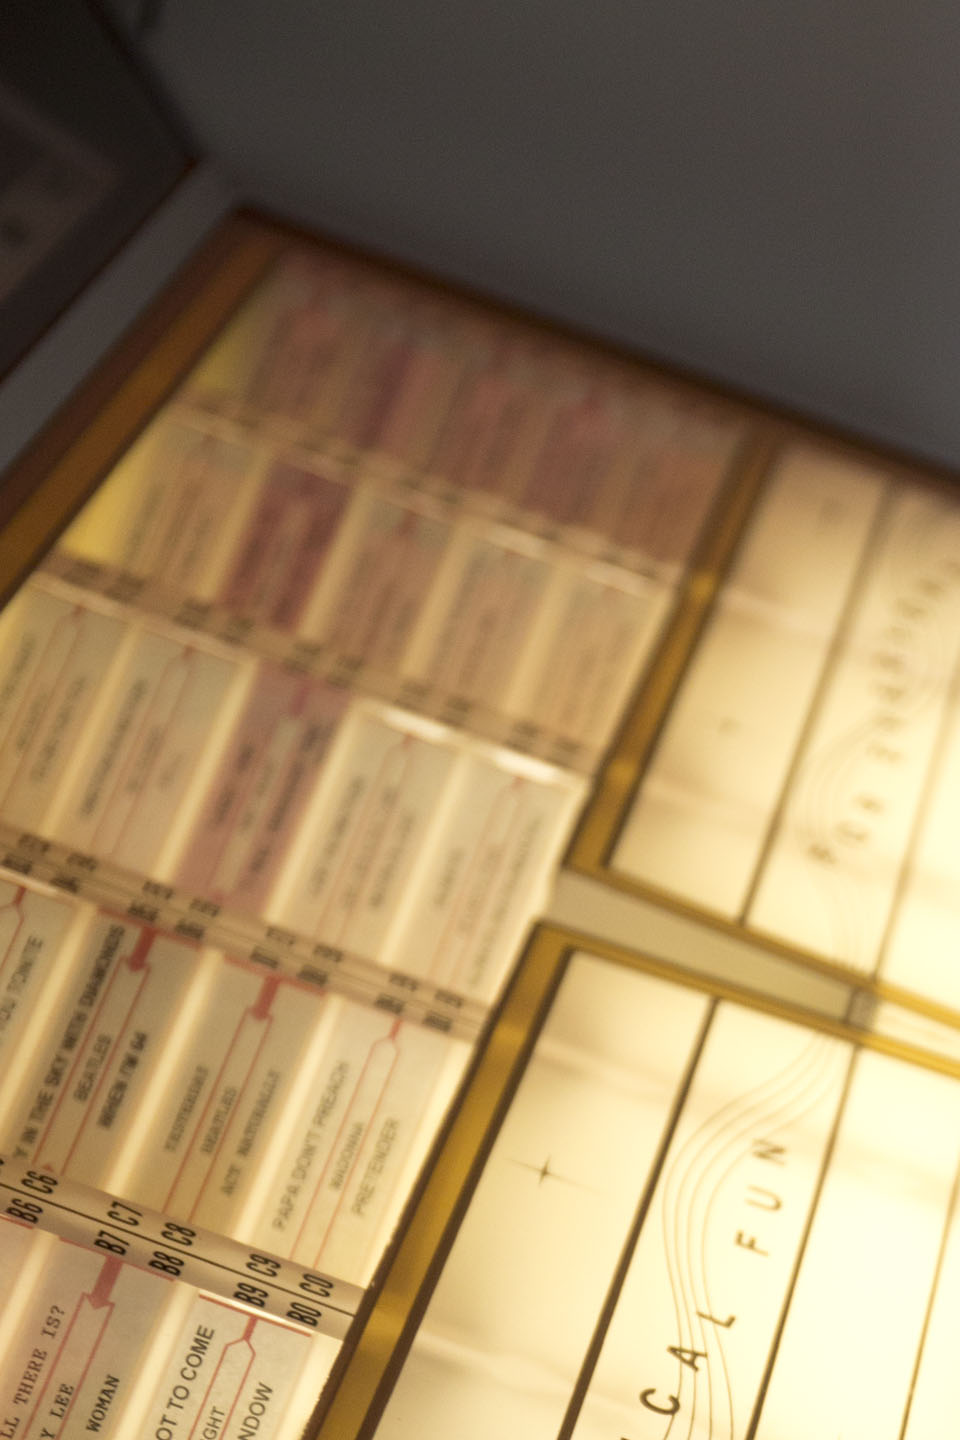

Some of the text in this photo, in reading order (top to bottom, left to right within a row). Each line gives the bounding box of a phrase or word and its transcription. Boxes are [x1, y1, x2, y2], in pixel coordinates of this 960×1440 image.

[44, 1054, 68, 1088] SKY
[272, 1187, 300, 1231] PAPA
[313, 1061, 349, 1130] PREACH
[21, 1170, 58, 1194] C6
[352, 1118, 399, 1217] PRETENDER
[5, 1198, 44, 1224] B6
[735, 1138, 787, 1257] FUN
[107, 1201, 143, 1227] C7
[94, 1230, 130, 1256] B7
[160, 1222, 196, 1247] C8
[148, 1251, 185, 1276] B8
[246, 1253, 282, 1278] C9
[233, 1282, 269, 1308] B9
[14, 1348, 48, 1405] THERE
[42, 1304, 65, 1338] IS?
[166, 1385, 190, 1410] TO
[180, 1324, 215, 1381] COME
[49, 1383, 75, 1420] LEE
[86, 1374, 120, 1433] WOMAN
